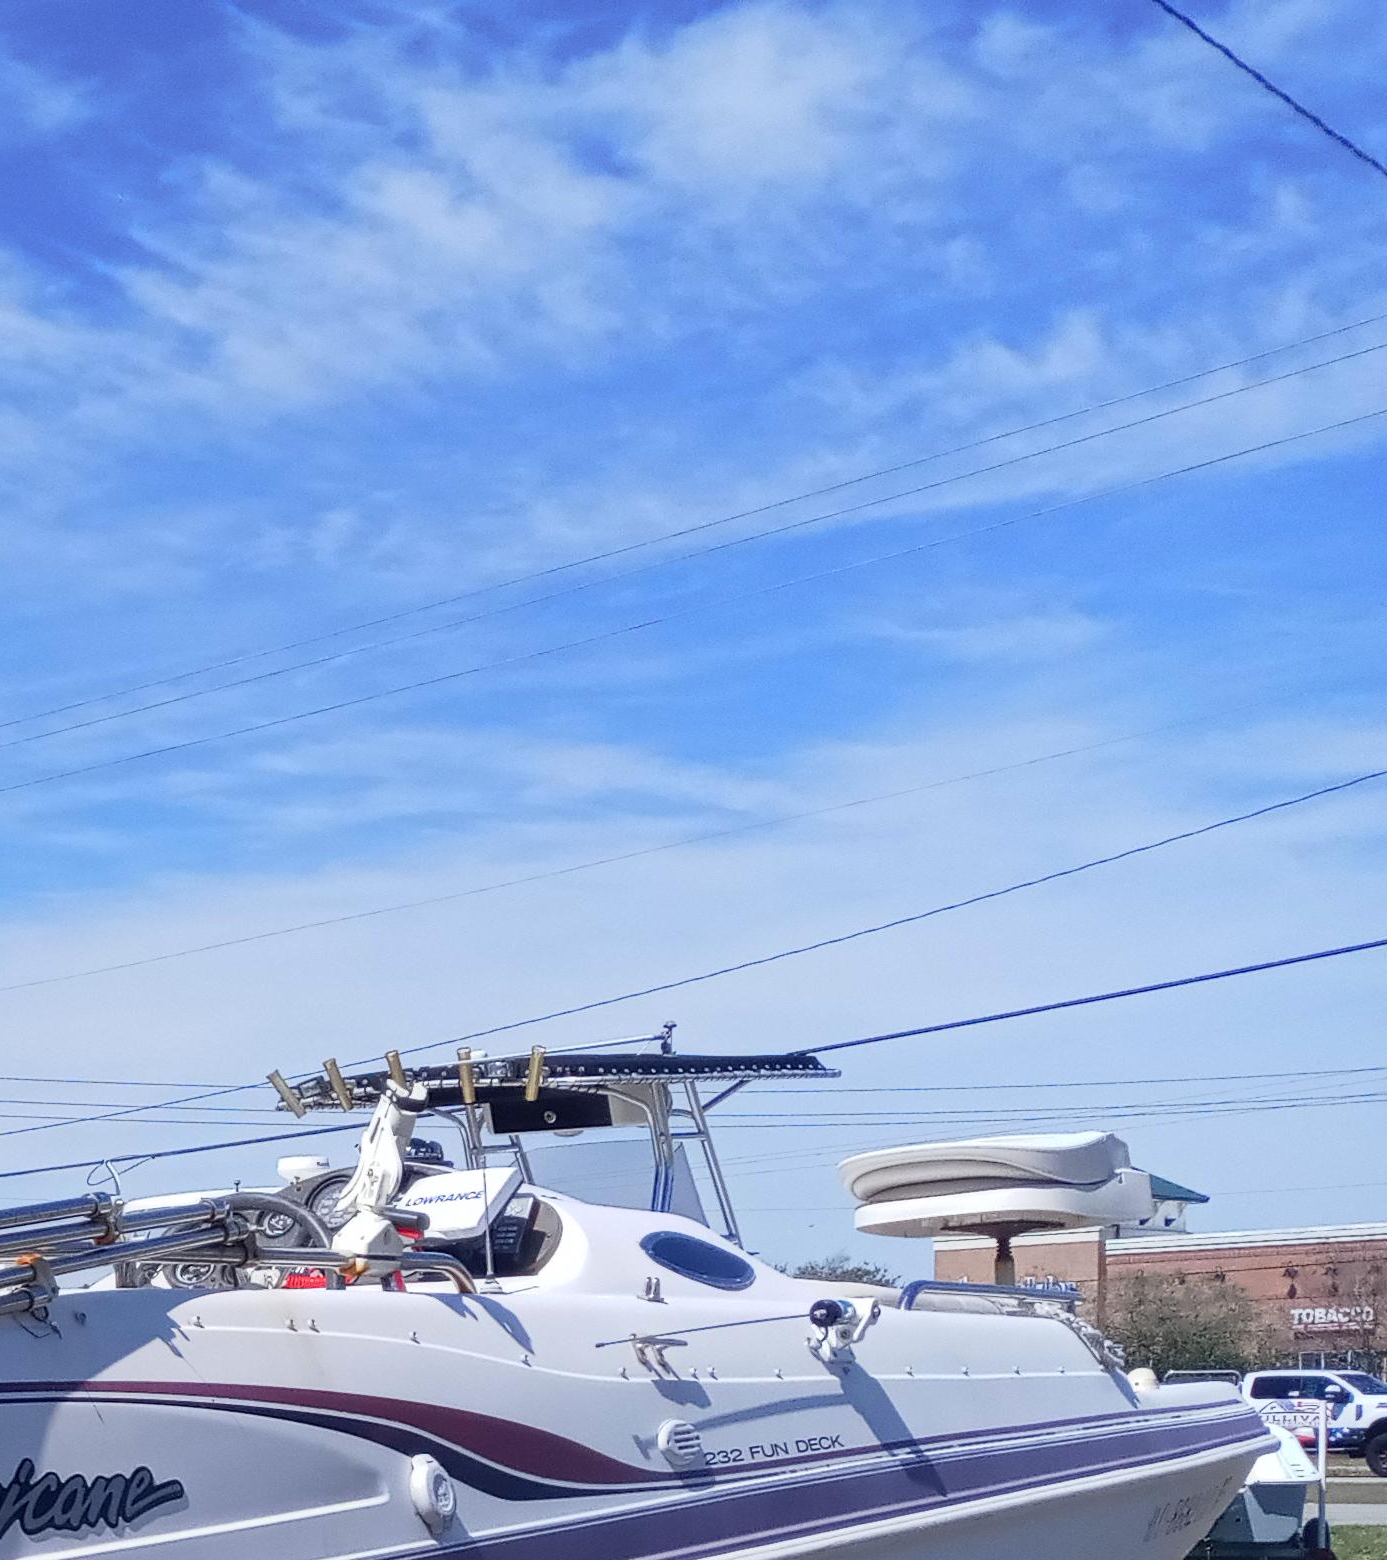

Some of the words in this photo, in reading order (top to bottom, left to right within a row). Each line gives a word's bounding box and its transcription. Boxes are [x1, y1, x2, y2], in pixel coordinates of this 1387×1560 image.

[405, 1191, 483, 1206] LOWRANCE
[703, 1449, 744, 1465] 232
[749, 1442, 789, 1460] FUN
[795, 1435, 844, 1453] DECK
